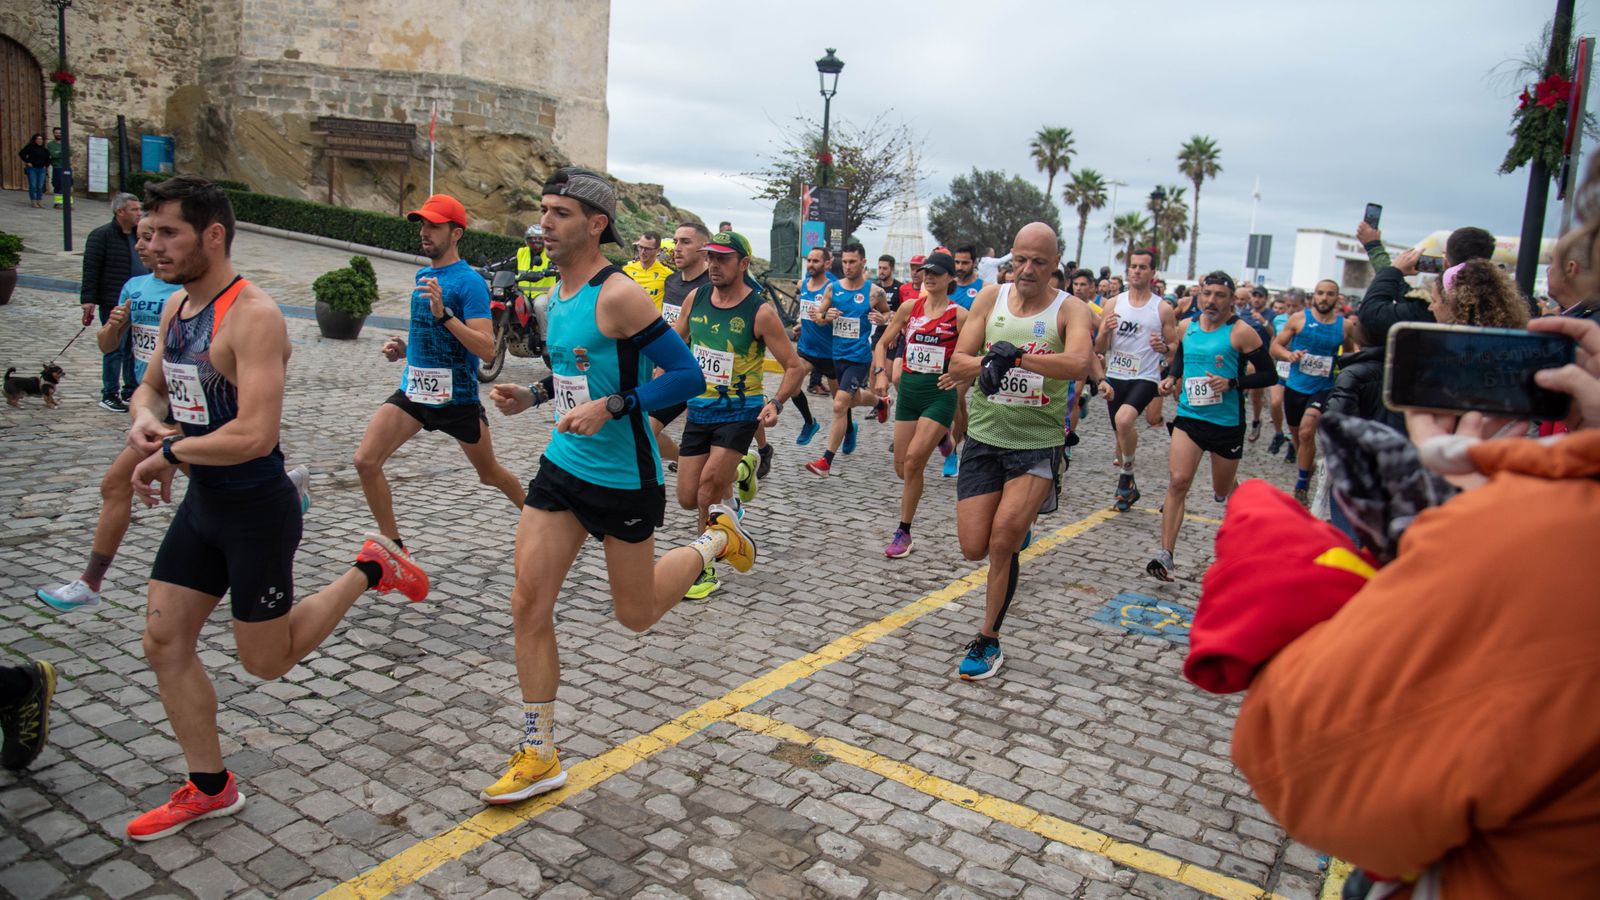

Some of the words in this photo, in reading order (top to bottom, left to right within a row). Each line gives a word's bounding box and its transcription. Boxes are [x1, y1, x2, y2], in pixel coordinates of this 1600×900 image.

[917, 351, 931, 364] 94
[417, 377, 439, 392] 152
[1000, 376, 1028, 394] 366
[1195, 384, 1208, 396] 89
